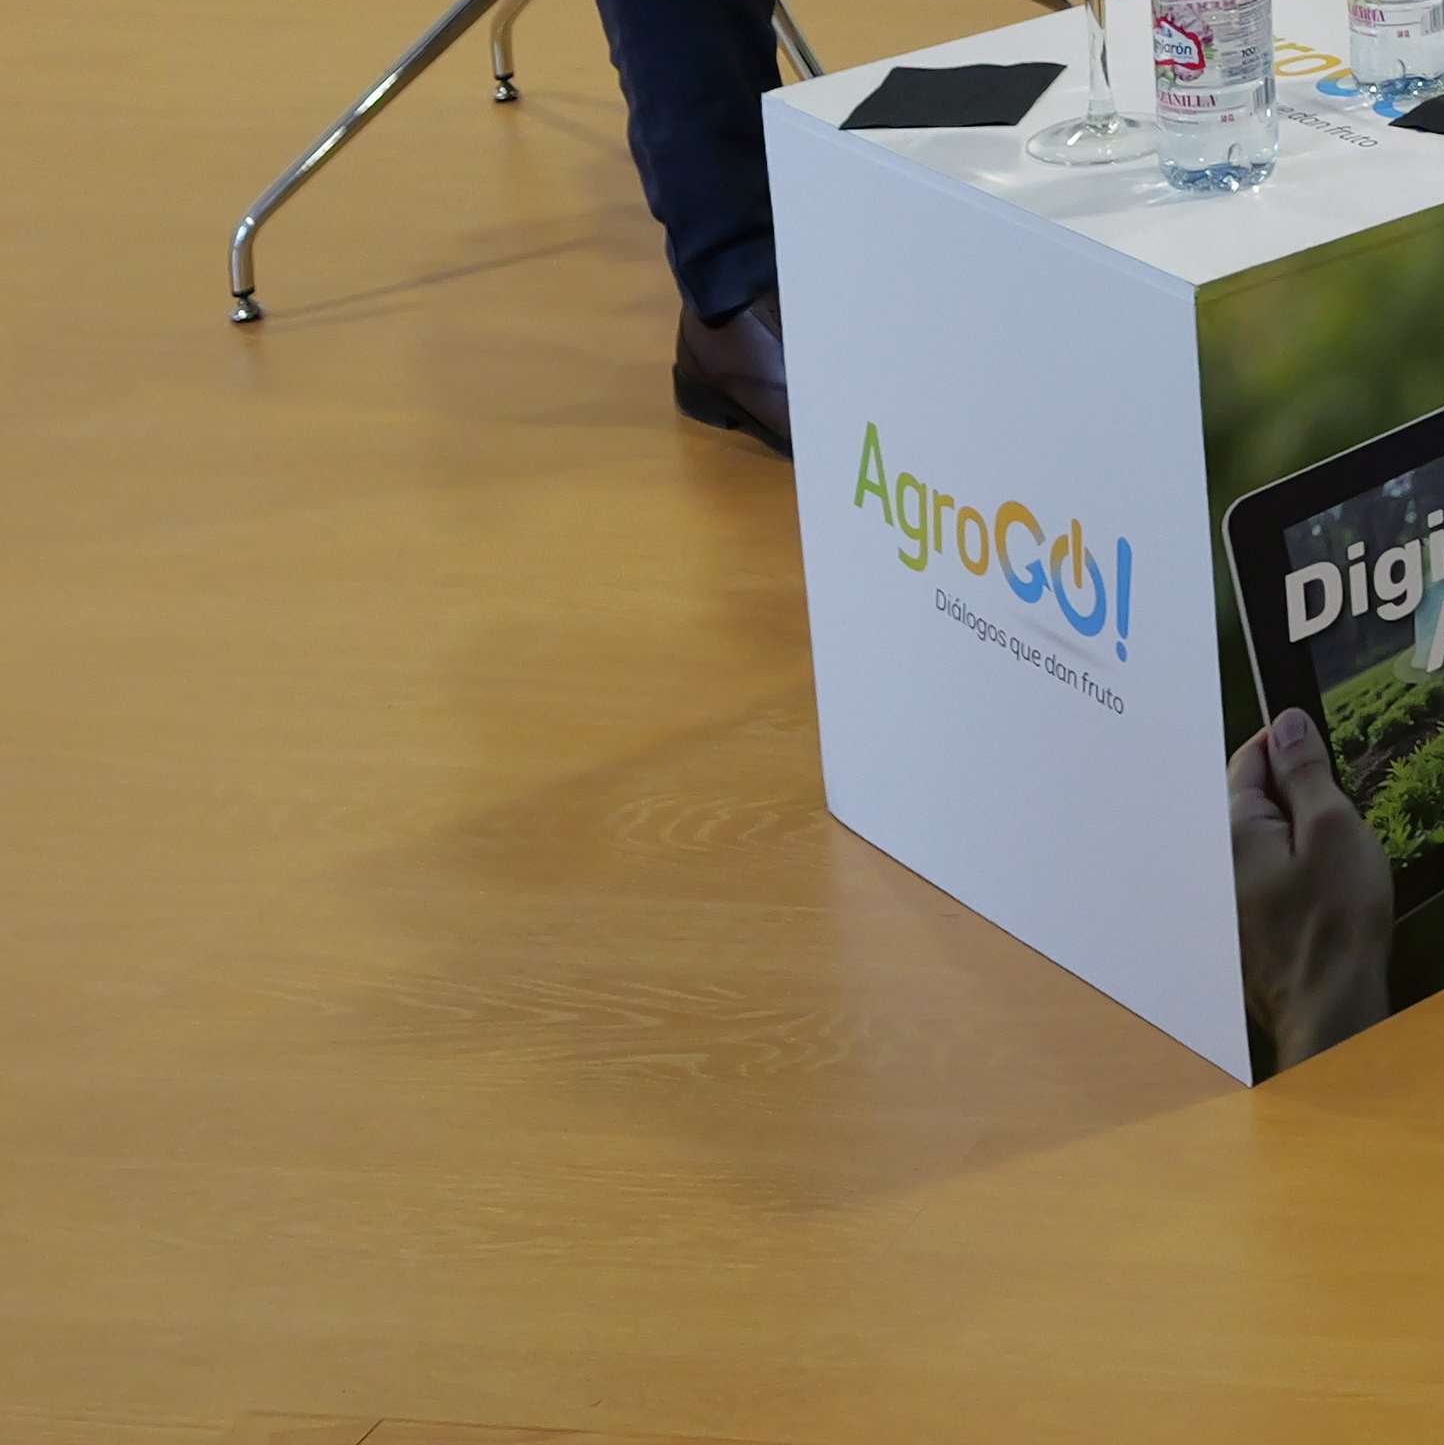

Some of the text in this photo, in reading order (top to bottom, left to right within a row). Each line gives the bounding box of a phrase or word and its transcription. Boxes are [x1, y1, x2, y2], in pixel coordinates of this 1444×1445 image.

[1324, 124, 1379, 148] fruto
[935, 588, 1125, 715] Diálogos que dan fruto
